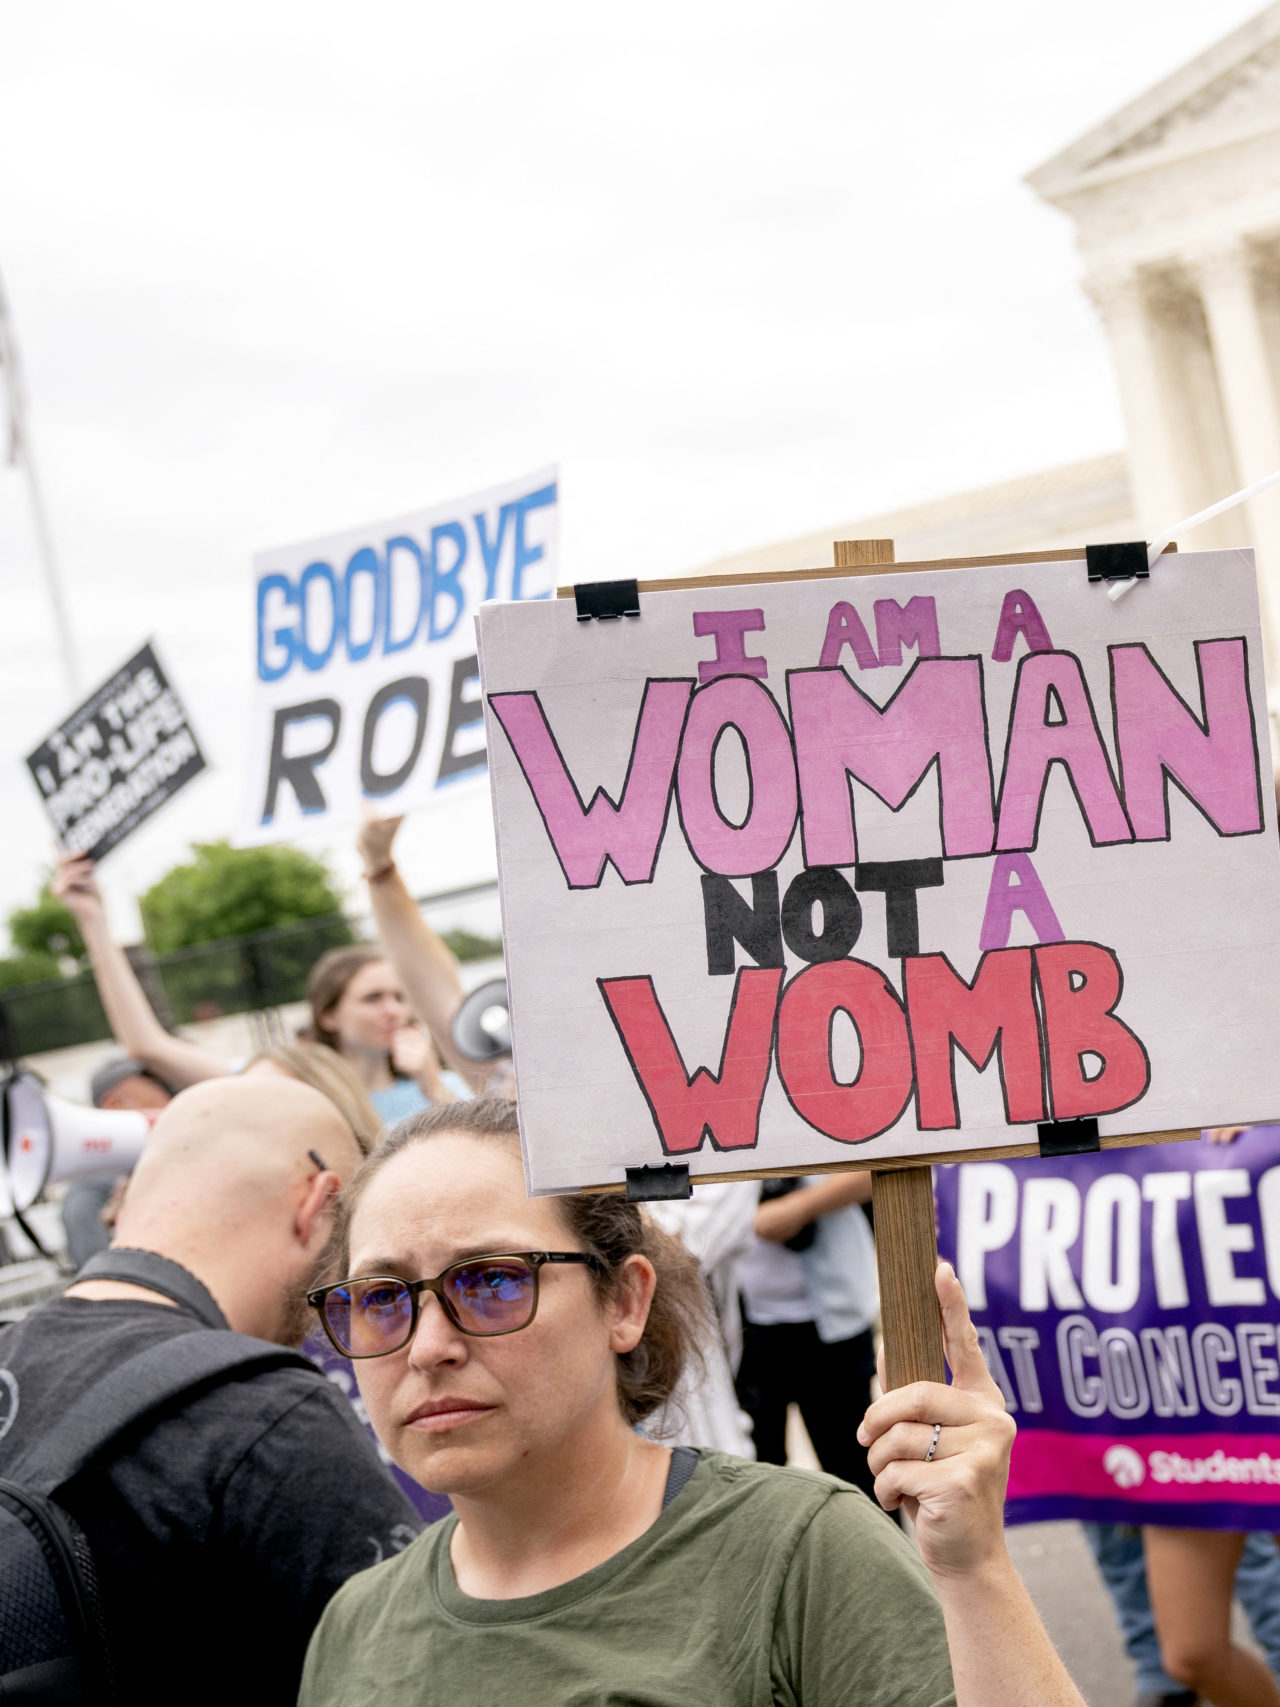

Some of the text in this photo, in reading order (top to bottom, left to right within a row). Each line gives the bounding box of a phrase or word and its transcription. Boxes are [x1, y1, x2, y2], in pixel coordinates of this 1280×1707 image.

[257, 482, 557, 683] GOODBYE
[693, 588, 1055, 684] I AM A
[48, 687, 185, 834] PRO-LIFE
[101, 667, 163, 731] THE
[259, 654, 489, 827] ROE
[486, 636, 1266, 891] WOMAN
[64, 728, 198, 855] GENERATION
[700, 852, 1066, 975] NOT A
[596, 940, 1152, 1156] WOMB
